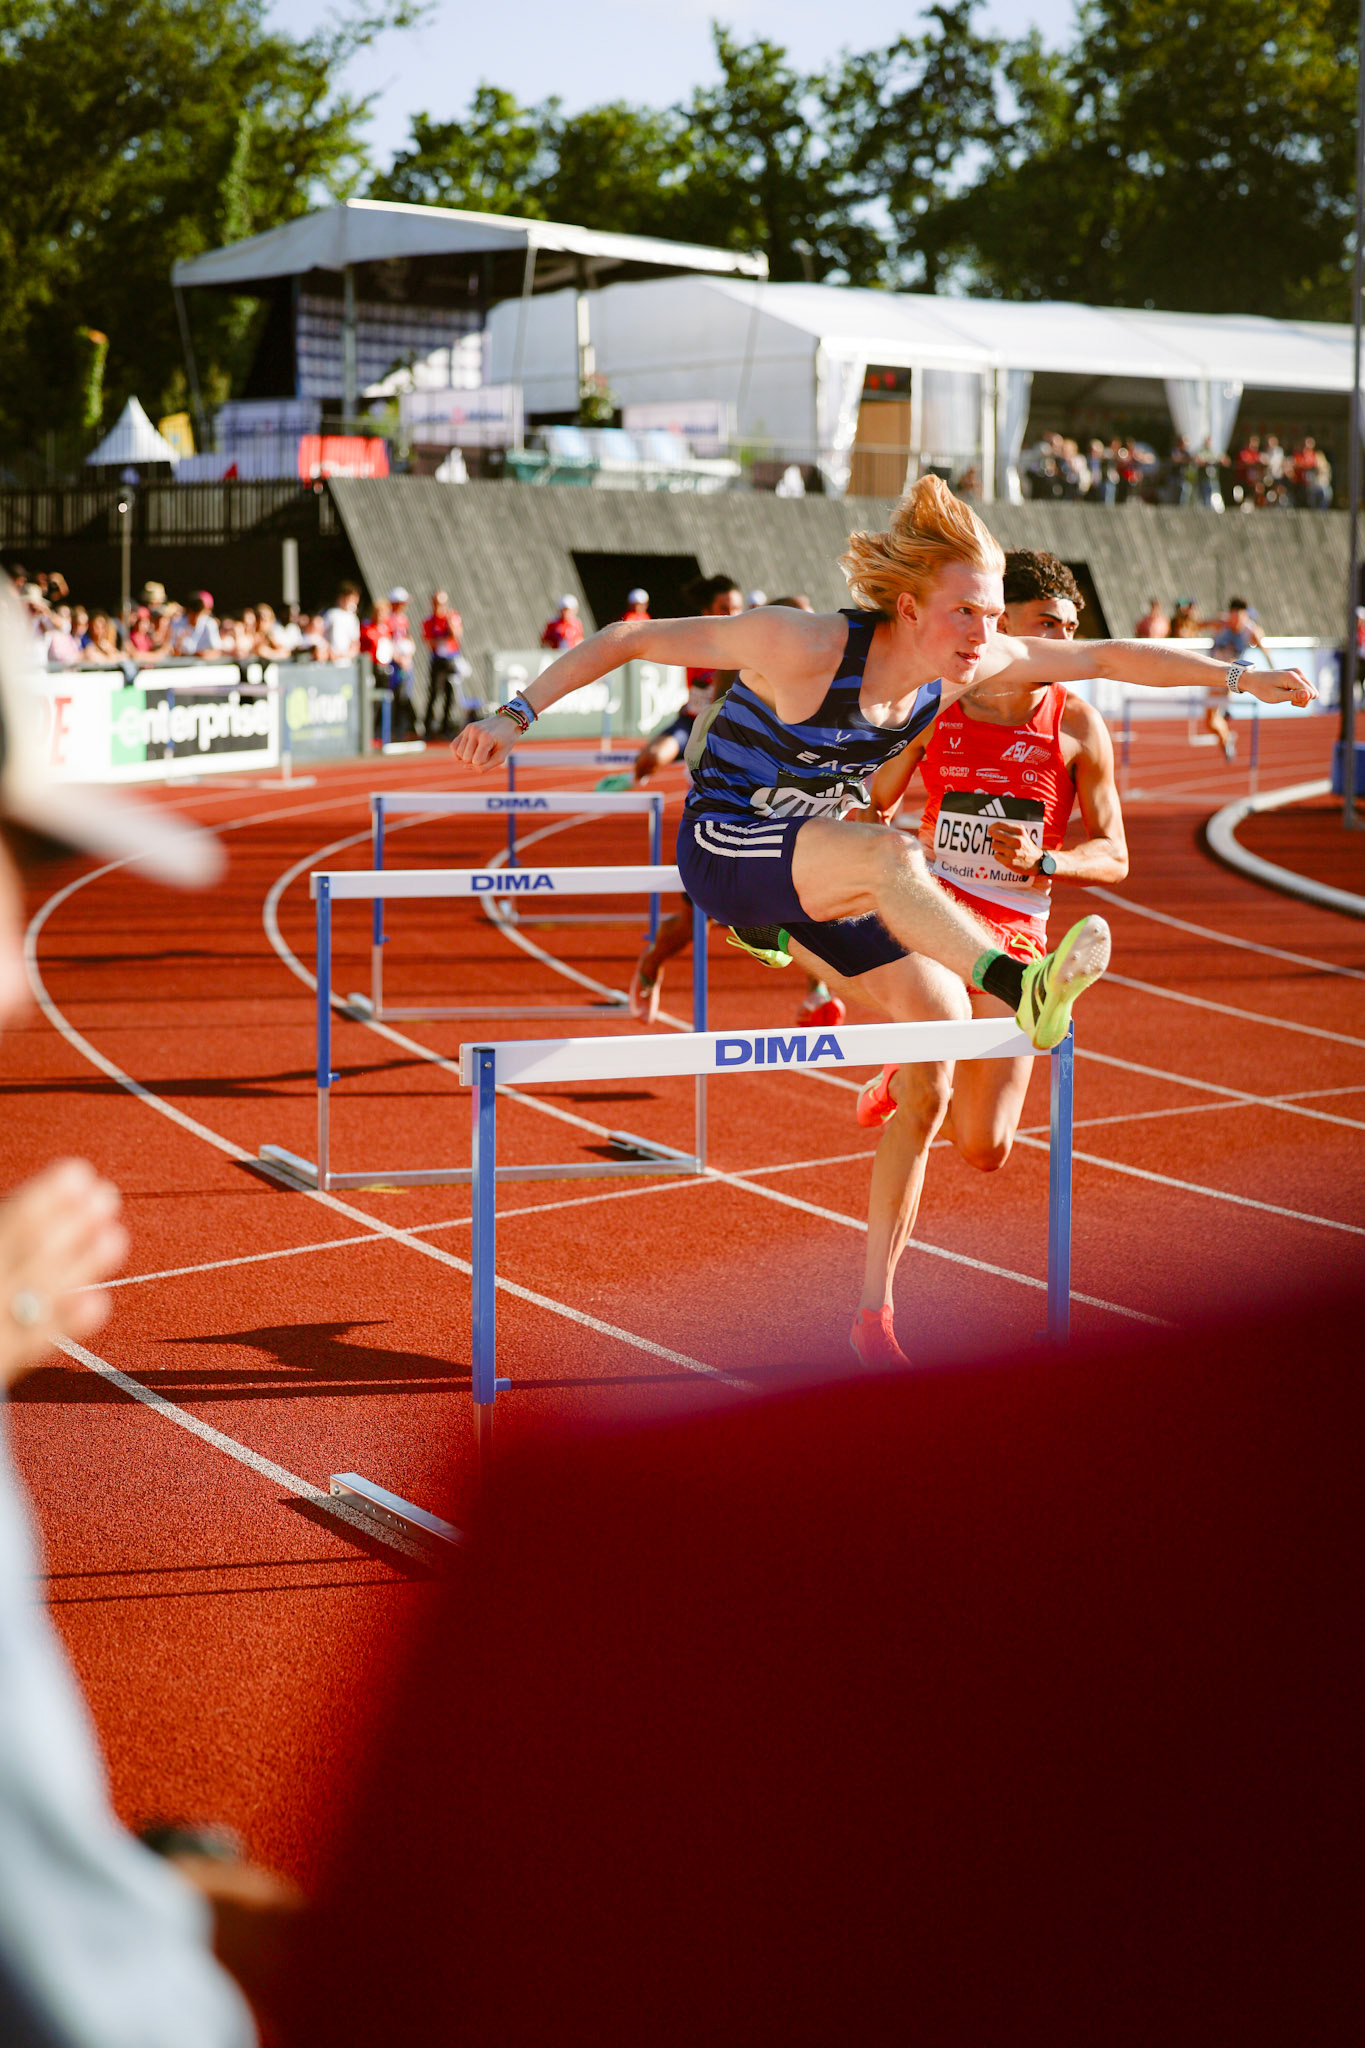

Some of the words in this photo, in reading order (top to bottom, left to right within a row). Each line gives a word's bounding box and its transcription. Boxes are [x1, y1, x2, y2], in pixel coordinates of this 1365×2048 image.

[116, 691, 270, 751] enterprise
[486, 798, 549, 810] DIMA
[471, 874, 555, 892] DIMA
[941, 860, 974, 878] Crédit
[990, 869, 1029, 883] Mutue
[715, 1033, 845, 1067] DIMA
